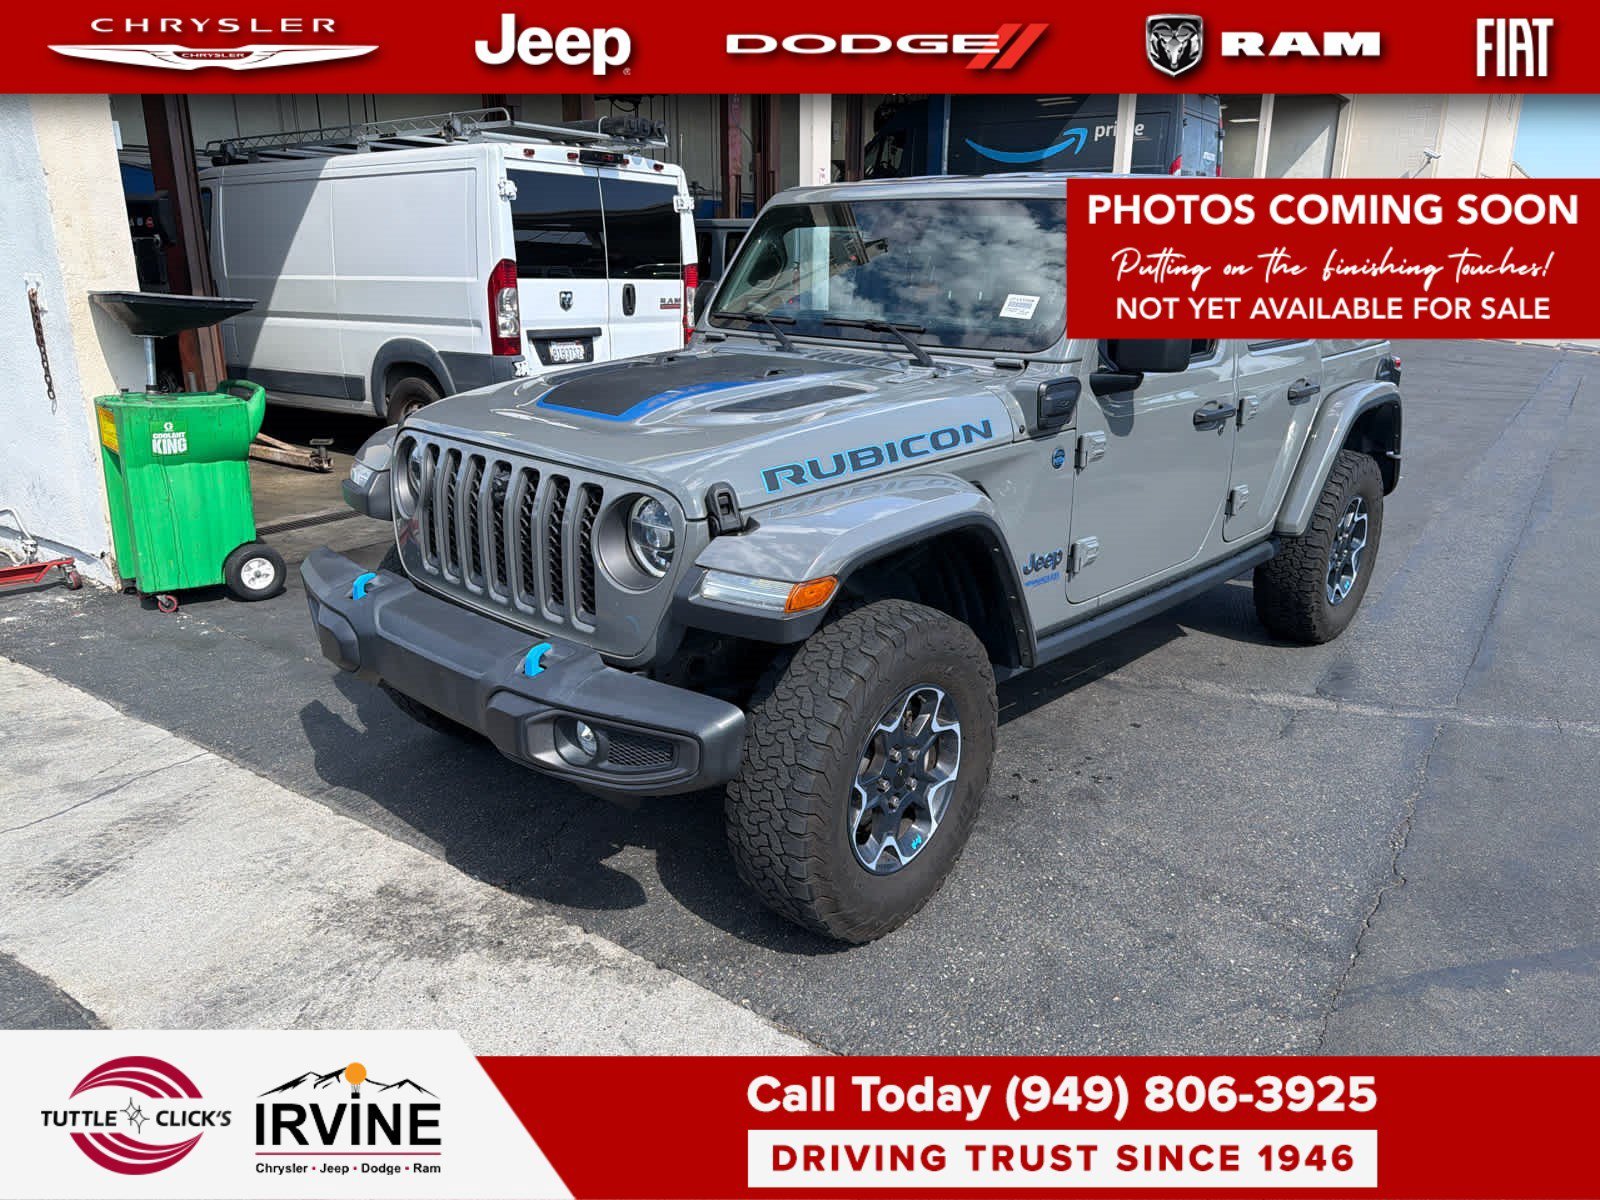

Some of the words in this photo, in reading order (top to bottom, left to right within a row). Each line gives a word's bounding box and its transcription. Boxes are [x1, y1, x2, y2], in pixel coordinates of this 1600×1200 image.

[1094, 121, 1145, 142] prie
[152, 438, 187, 454] KING
[760, 418, 994, 495] RUBICON
[1022, 549, 1063, 575] Jeep
